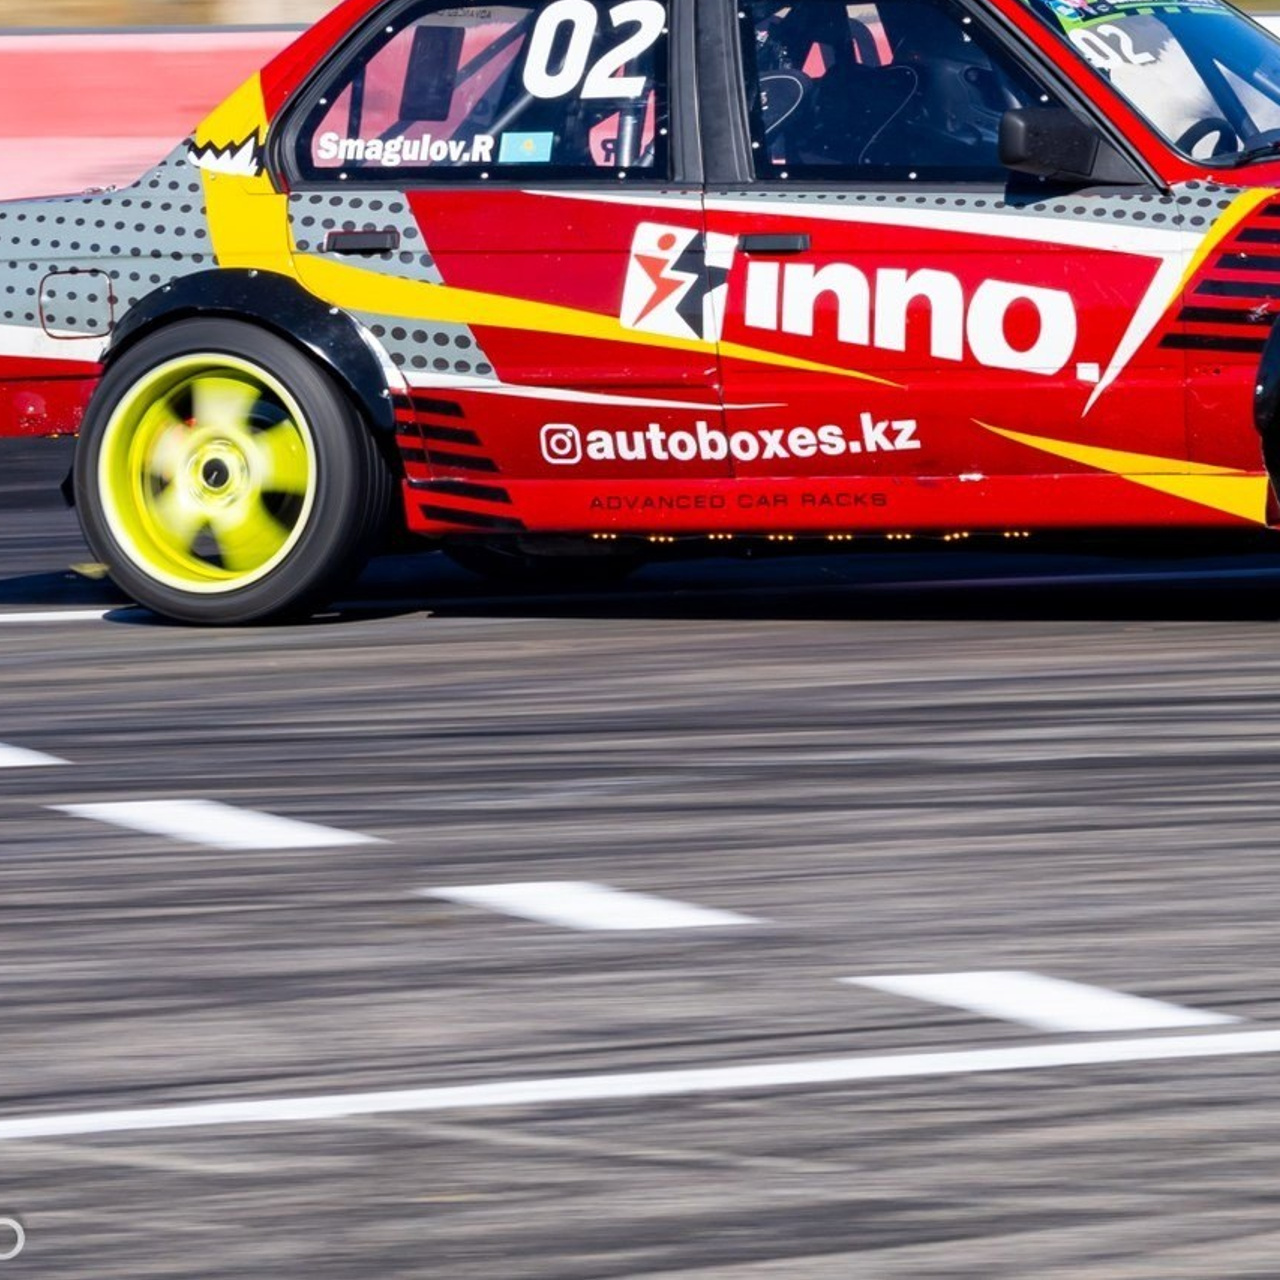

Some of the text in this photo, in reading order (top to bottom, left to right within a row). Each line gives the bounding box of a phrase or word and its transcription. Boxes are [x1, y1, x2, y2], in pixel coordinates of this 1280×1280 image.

[1068, 23, 1155, 69] 02
[316, 132, 495, 166] Smagulov.R
[586, 412, 921, 462] autoboxes.kz
[590, 492, 888, 510] ADVANCED CAR RACKS
